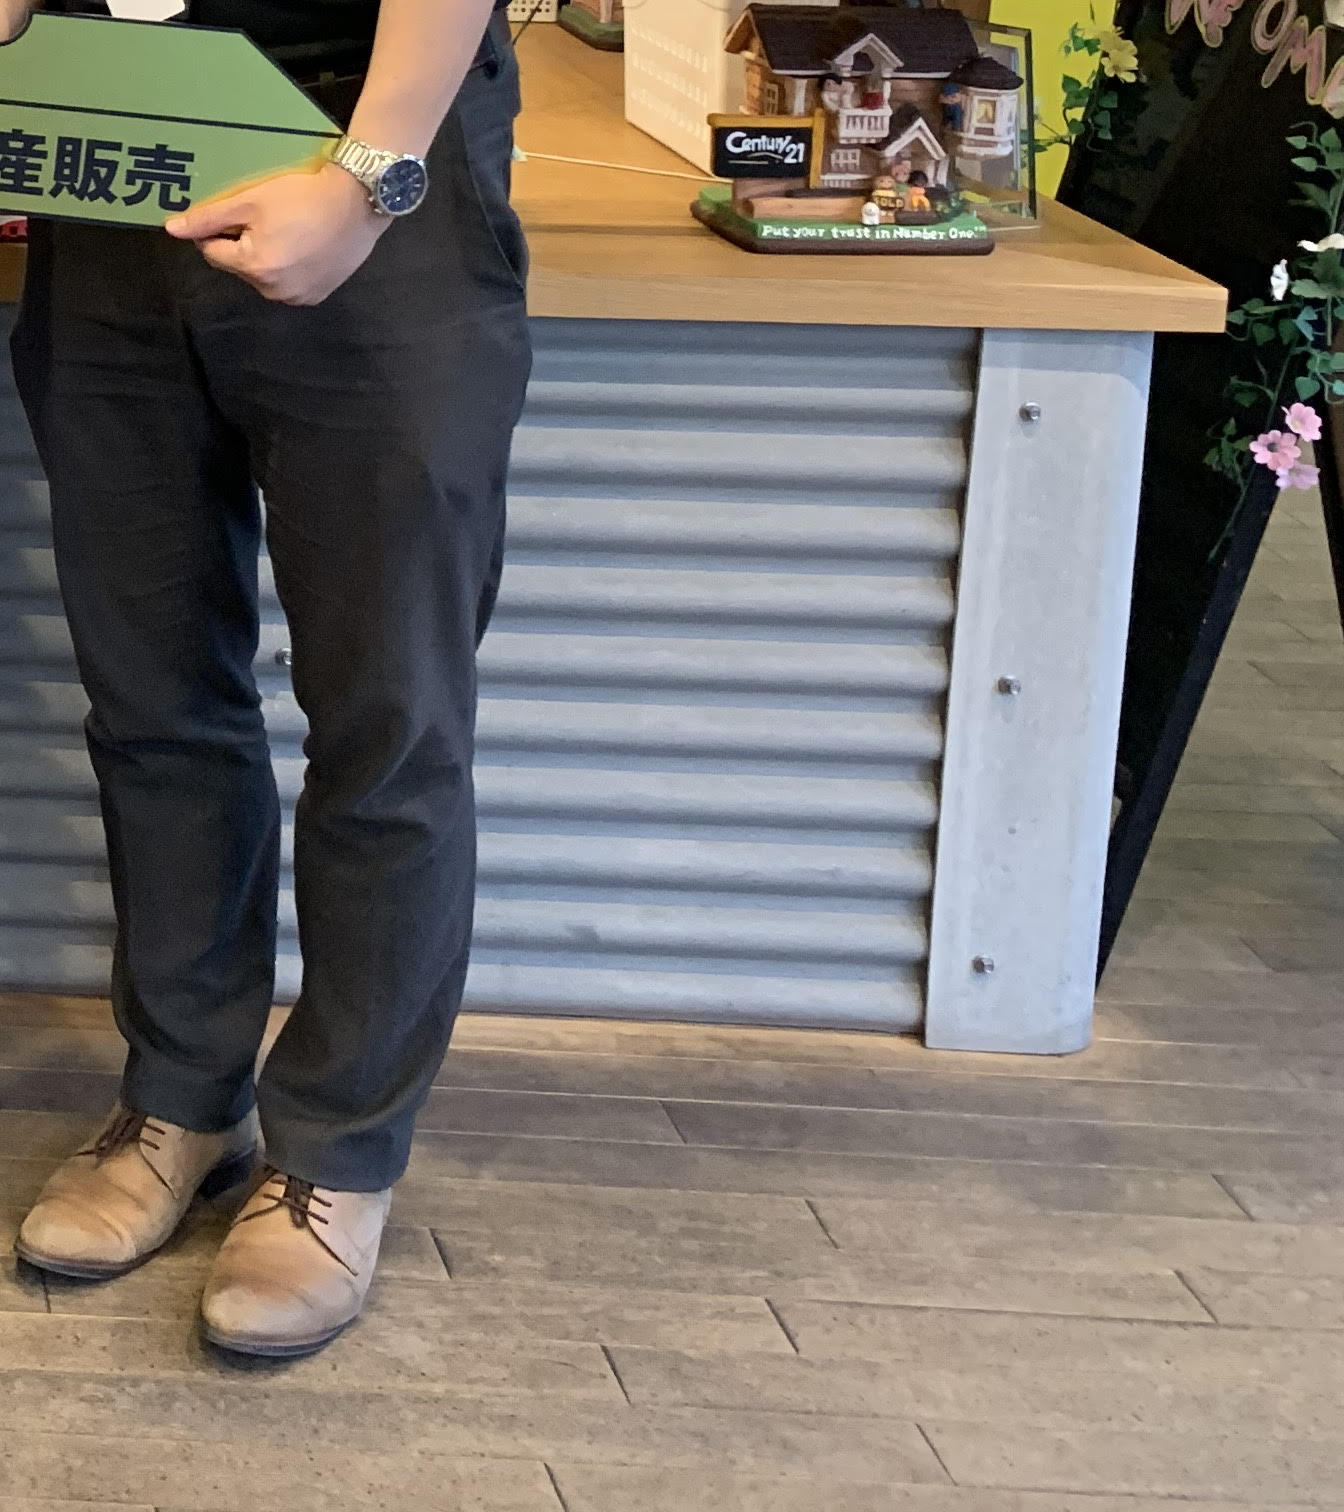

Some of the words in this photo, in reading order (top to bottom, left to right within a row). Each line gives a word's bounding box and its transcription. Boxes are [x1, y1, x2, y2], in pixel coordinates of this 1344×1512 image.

[725, 131, 792, 153] Century
[784, 142, 805, 164] 21
[762, 225, 790, 237] Put
[793, 228, 825, 239] your
[831, 226, 871, 238] trust
[875, 228, 891, 239] in
[893, 227, 945, 240] Number
